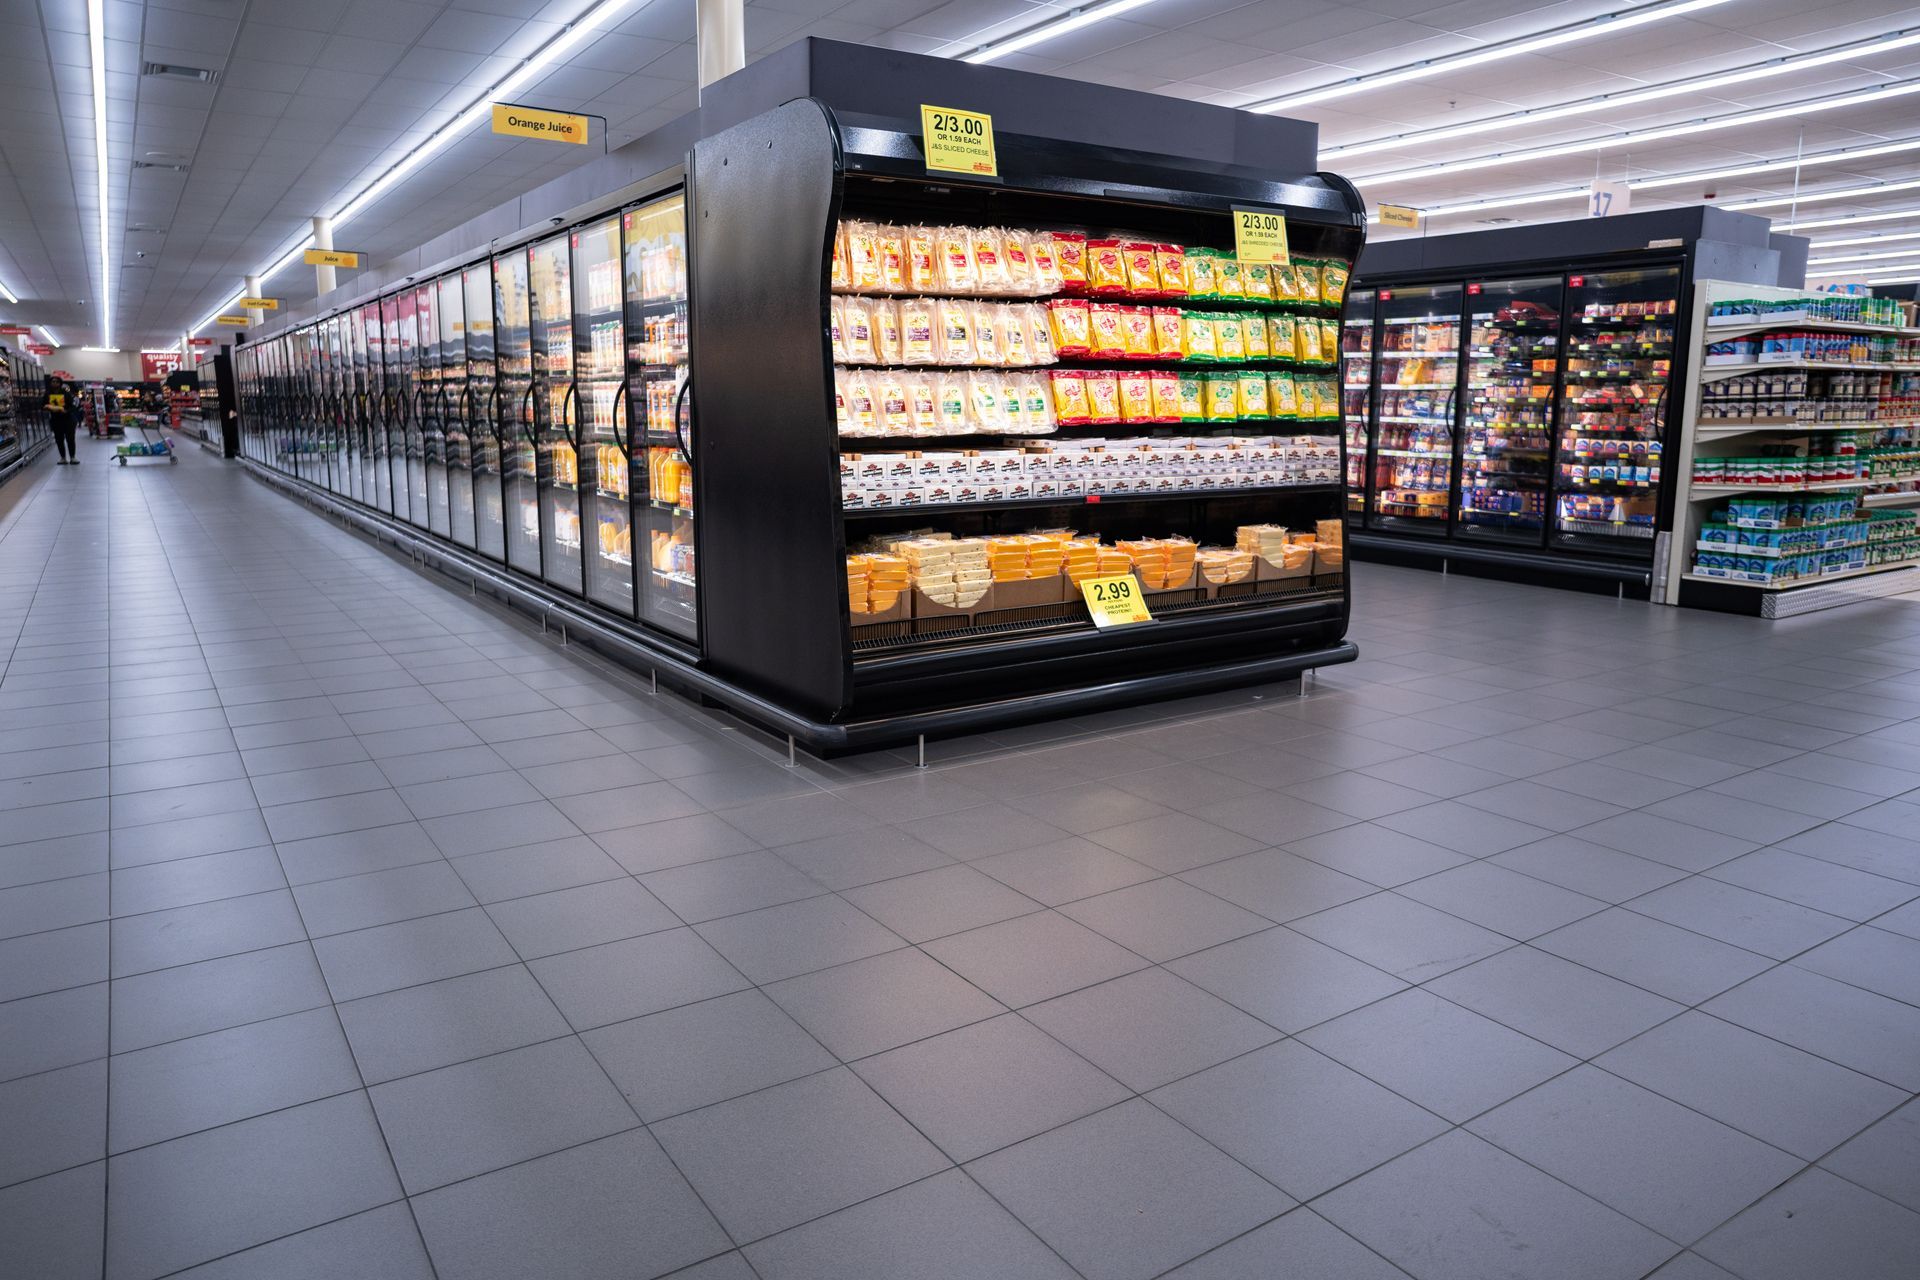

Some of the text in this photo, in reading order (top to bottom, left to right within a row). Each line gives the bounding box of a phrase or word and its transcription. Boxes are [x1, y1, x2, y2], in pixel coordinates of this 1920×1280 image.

[508, 116, 572, 134] Orange Juice
[934, 114, 982, 136] 2/3.00
[964, 137, 982, 145] EACH
[944, 144, 965, 152] SLICED
[966, 148, 989, 156] CHEESE
[1594, 192, 1612, 216] 17
[1242, 214, 1278, 230] 2/3.00
[147, 353, 178, 363] quality
[1094, 582, 1130, 601] 2.99
[1104, 602, 1130, 610] CHEAPEST
